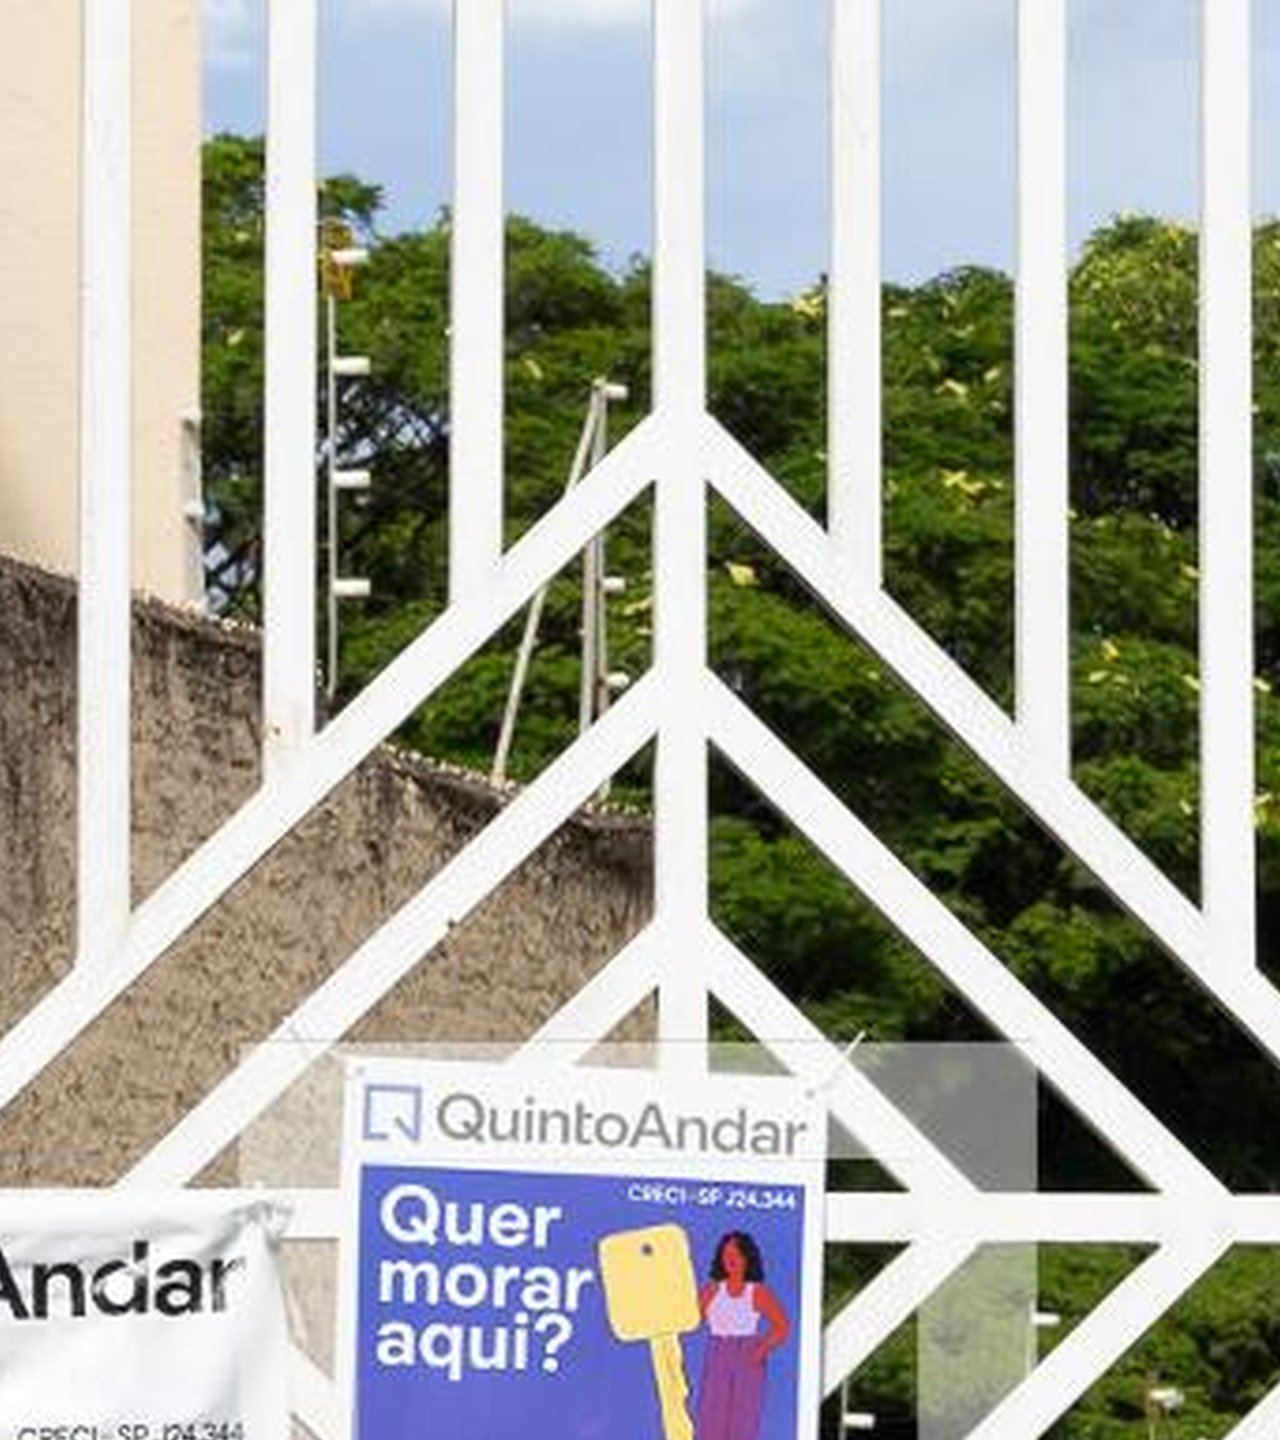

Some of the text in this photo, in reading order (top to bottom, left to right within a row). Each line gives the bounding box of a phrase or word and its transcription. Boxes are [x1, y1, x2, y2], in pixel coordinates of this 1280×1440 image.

[434, 1092, 809, 1156] QuintoAndar
[380, 1183, 562, 1247] Quer
[377, 1258, 595, 1312] morar
[375, 1313, 573, 1381] aqui?
